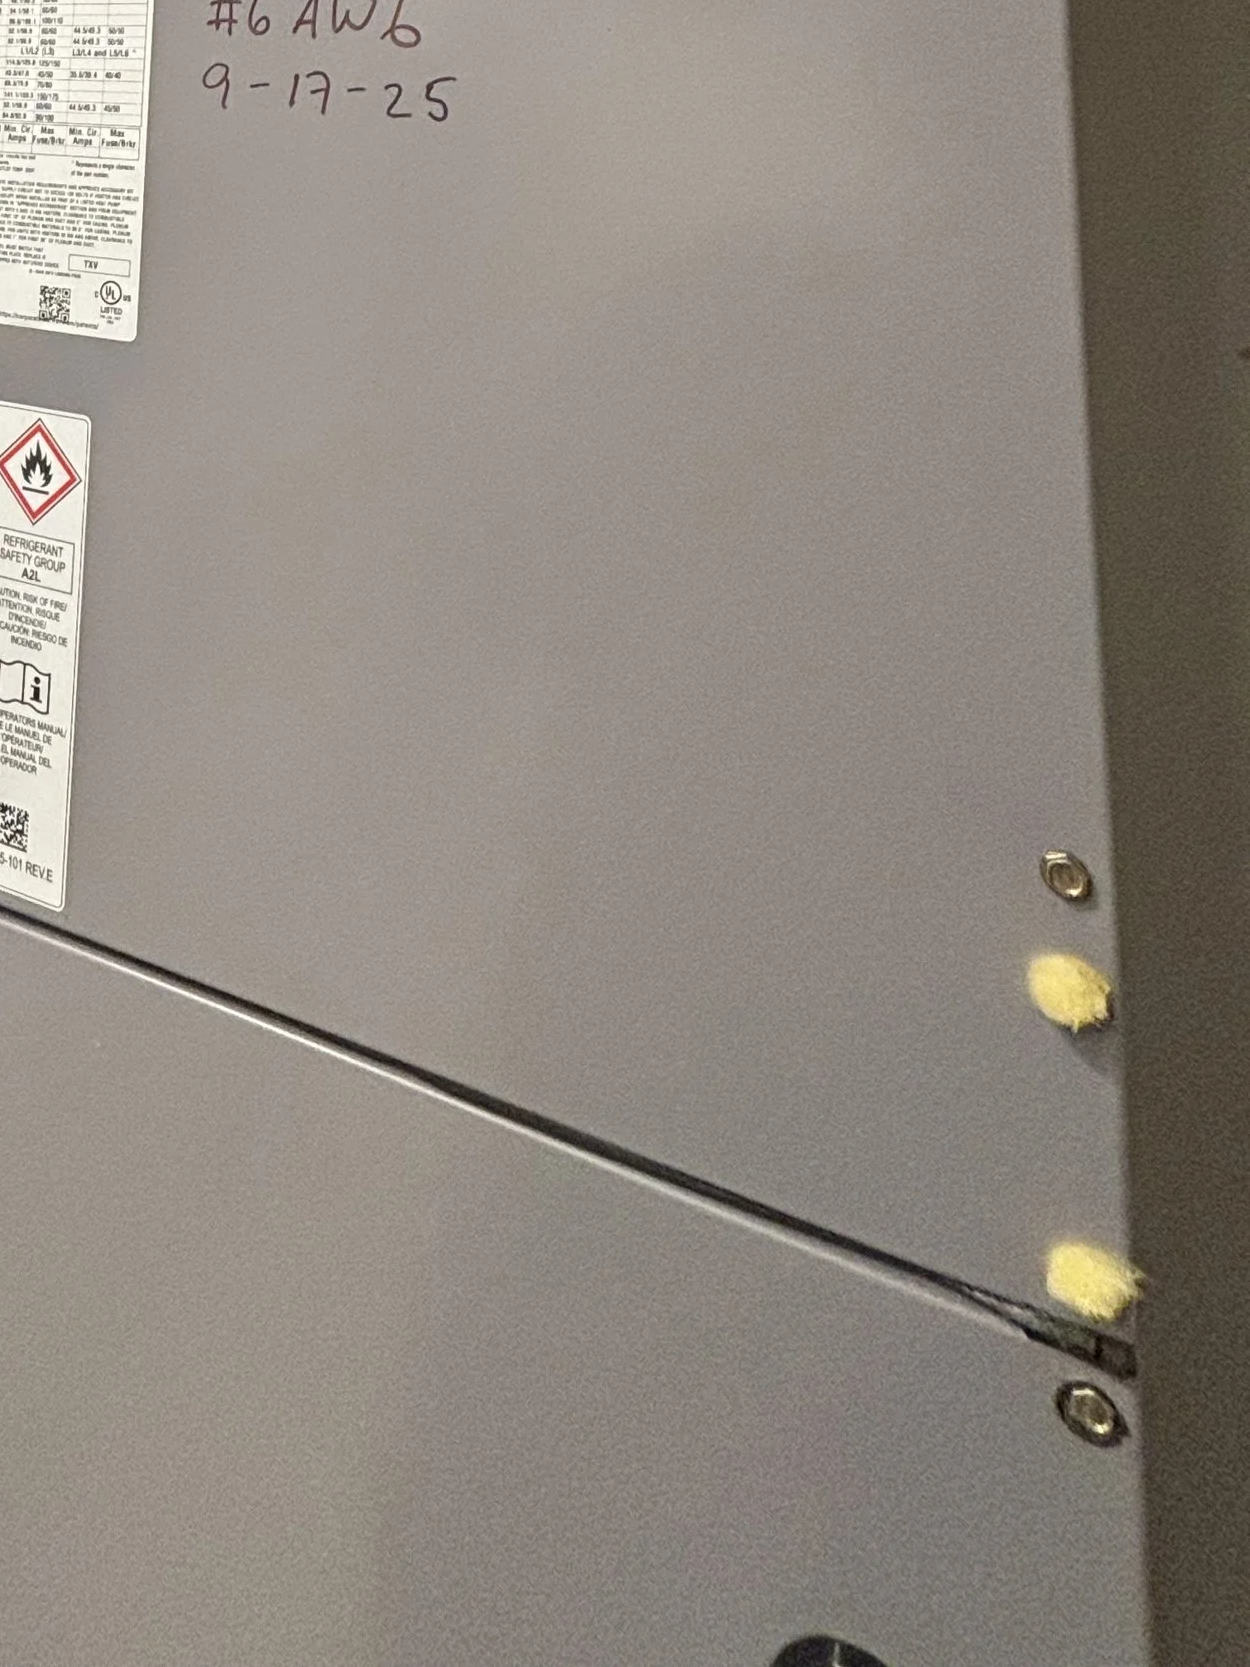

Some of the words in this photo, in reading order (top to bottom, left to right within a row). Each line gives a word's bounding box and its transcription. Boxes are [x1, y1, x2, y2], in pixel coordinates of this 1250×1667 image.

[3, 533, 63, 558] REFRIGERANT
[0, 547, 32, 565] SAFETY
[34, 555, 65, 574] GROUP
[21, 567, 41, 582] A2L
